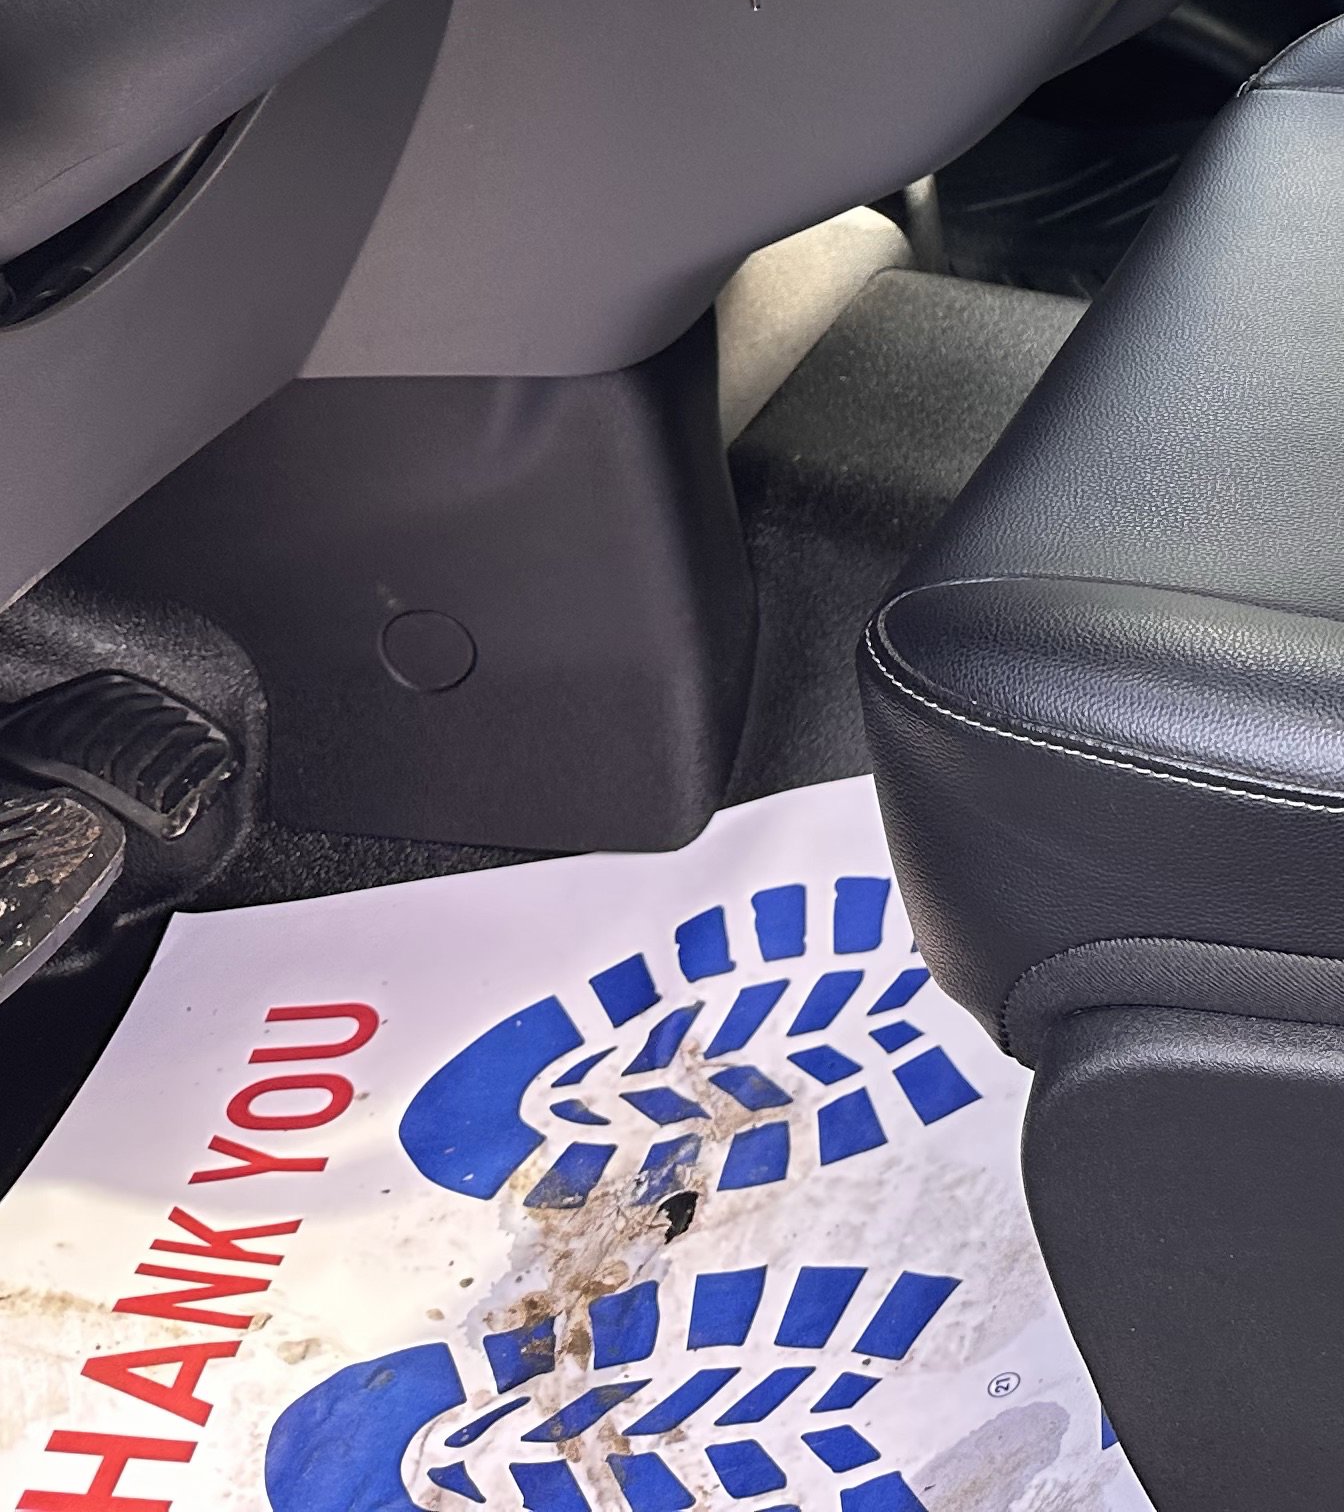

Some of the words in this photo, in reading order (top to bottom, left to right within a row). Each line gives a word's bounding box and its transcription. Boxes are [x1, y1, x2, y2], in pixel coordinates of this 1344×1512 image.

[14, 1206, 304, 1512] HANK
[187, 1001, 380, 1185] YOU
[994, 1377, 1011, 1393] 21
